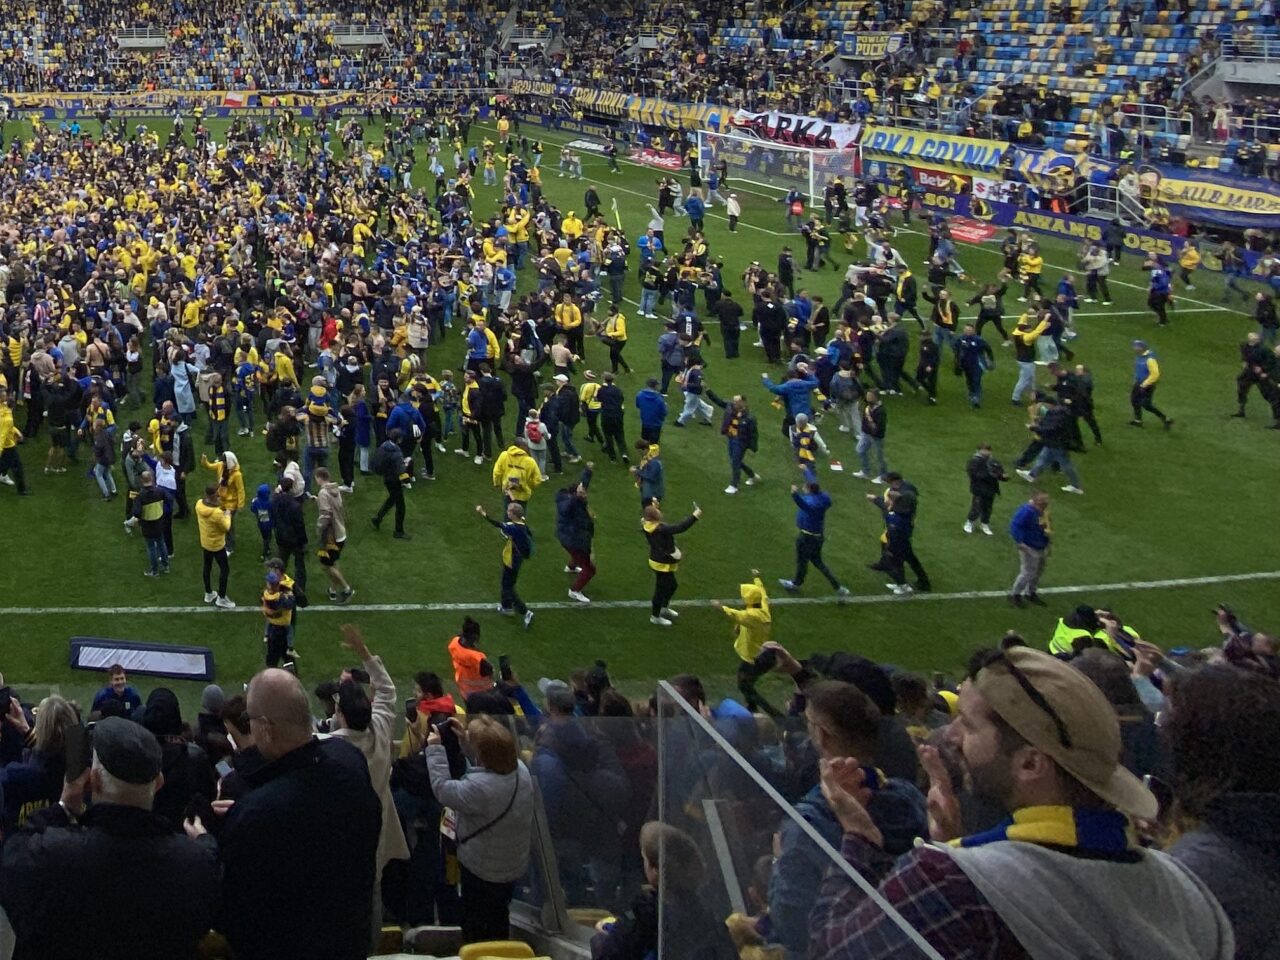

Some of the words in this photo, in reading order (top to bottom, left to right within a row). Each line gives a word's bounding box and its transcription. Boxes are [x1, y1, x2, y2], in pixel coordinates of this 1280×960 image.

[919, 138, 1002, 168] GDYNIA
[1014, 211, 1102, 241] AWANS
[1123, 232, 1173, 256] 025
